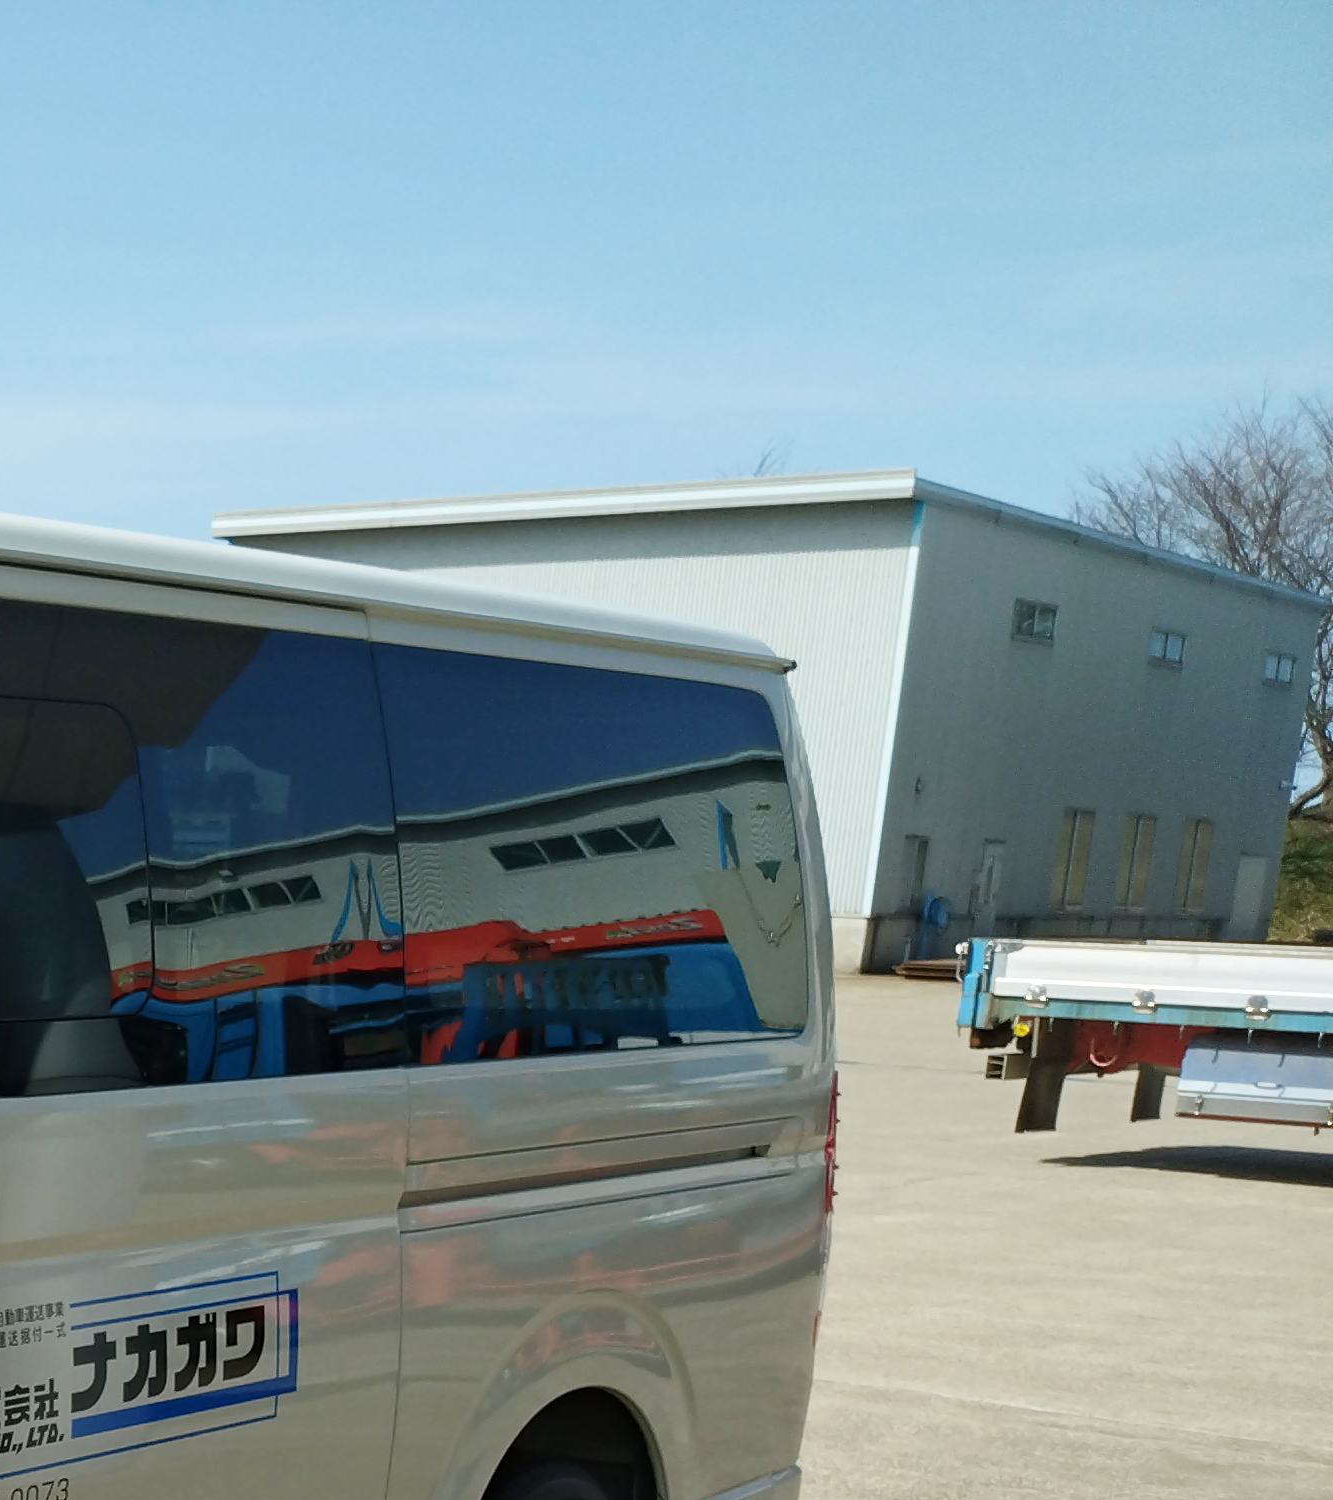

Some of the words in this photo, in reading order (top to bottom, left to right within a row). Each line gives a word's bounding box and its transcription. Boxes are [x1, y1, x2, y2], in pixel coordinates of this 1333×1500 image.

[70, 1304, 266, 1414] ナカガワ
[26, 1423, 65, 1449] LTD.
